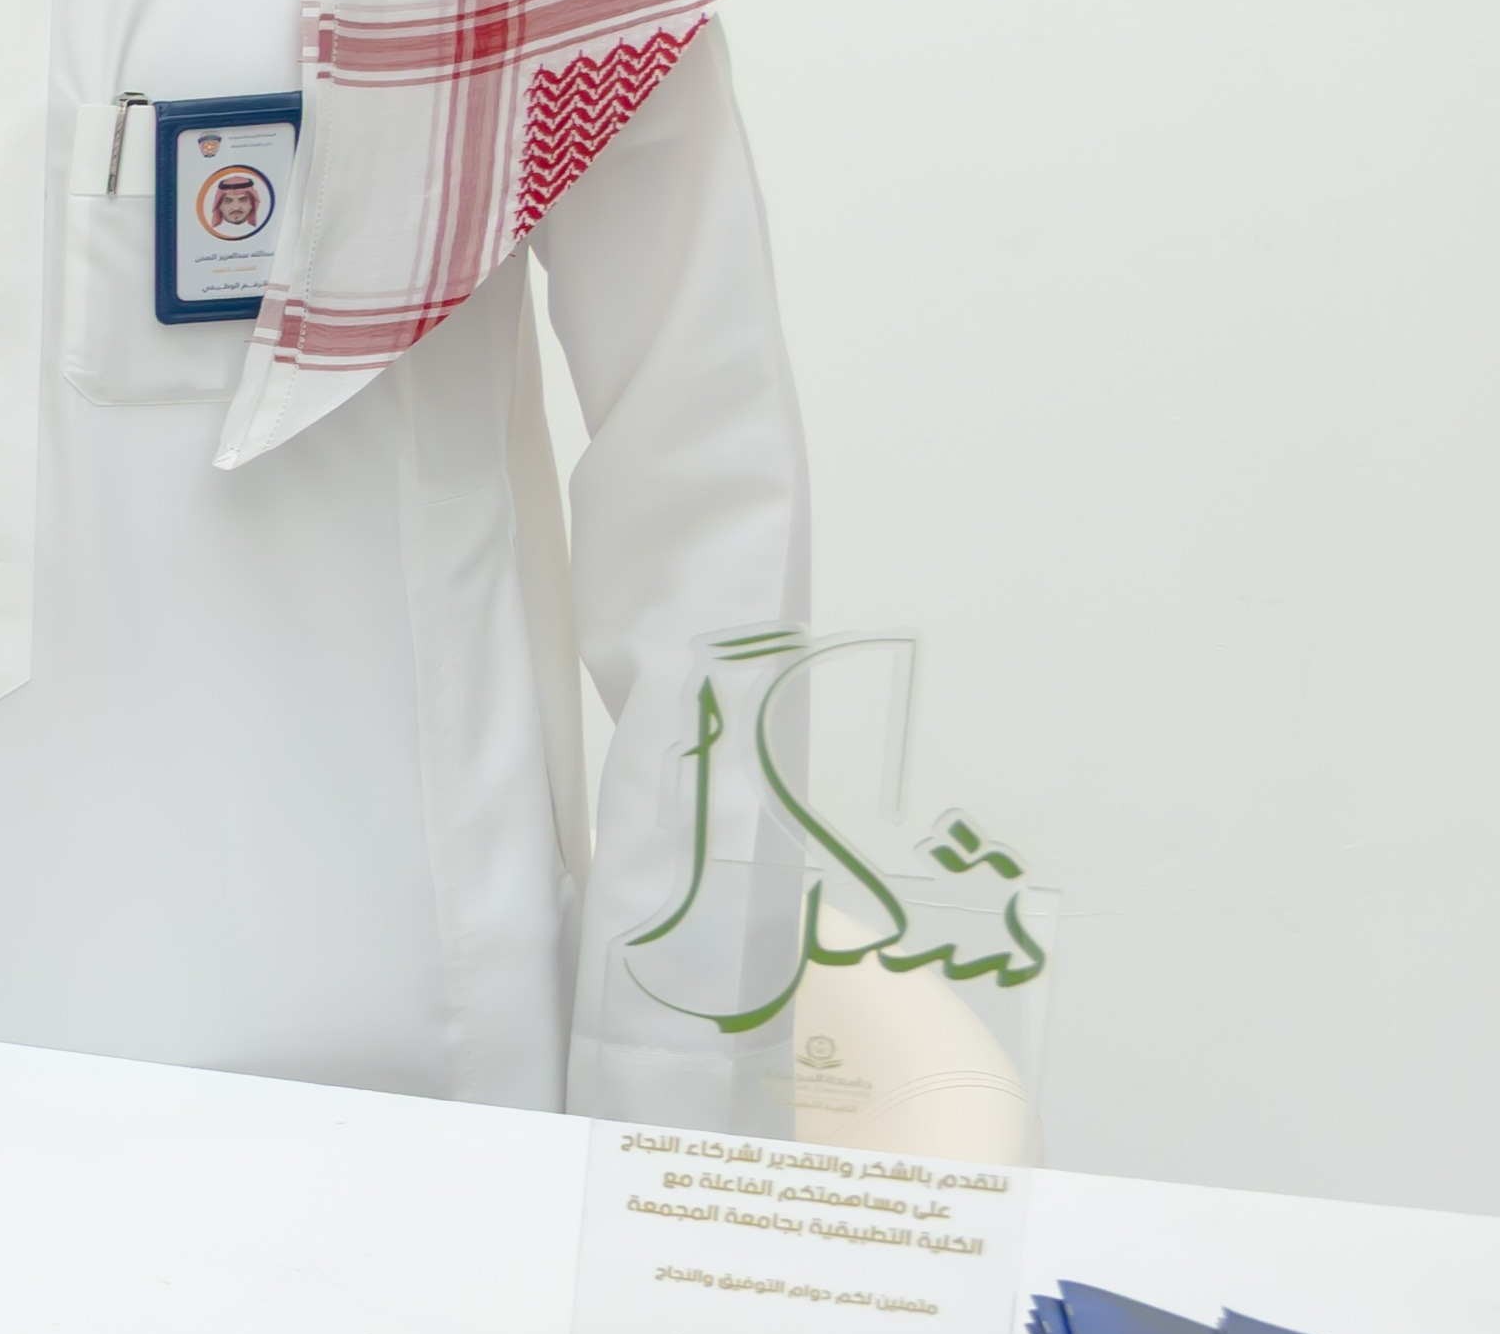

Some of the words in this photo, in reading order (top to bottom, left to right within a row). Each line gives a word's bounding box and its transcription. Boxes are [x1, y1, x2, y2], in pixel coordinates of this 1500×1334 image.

[620, 1132, 681, 1154] النجاح
[685, 1141, 762, 1164] لشركاء
[766, 1152, 855, 1179] والتقدير
[859, 1160, 933, 1189] بالشكر
[663, 1171, 693, 1189] مع
[699, 1171, 774, 1196] الفاعلة
[937, 1173, 1009, 1193] نتقدم
[627, 1195, 719, 1221] المجمعة
[777, 1184, 907, 1215] مساهمتكم
[912, 1200, 952, 1220] على
[724, 1206, 803, 1236] بجامعة
[808, 1217, 912, 1246] التطبيقية
[917, 1231, 984, 1256] الكلية
[654, 1265, 714, 1288] والنجاح
[717, 1273, 785, 1295] التوفيق
[788, 1284, 832, 1302] دوام
[835, 1291, 872, 1306] لكم
